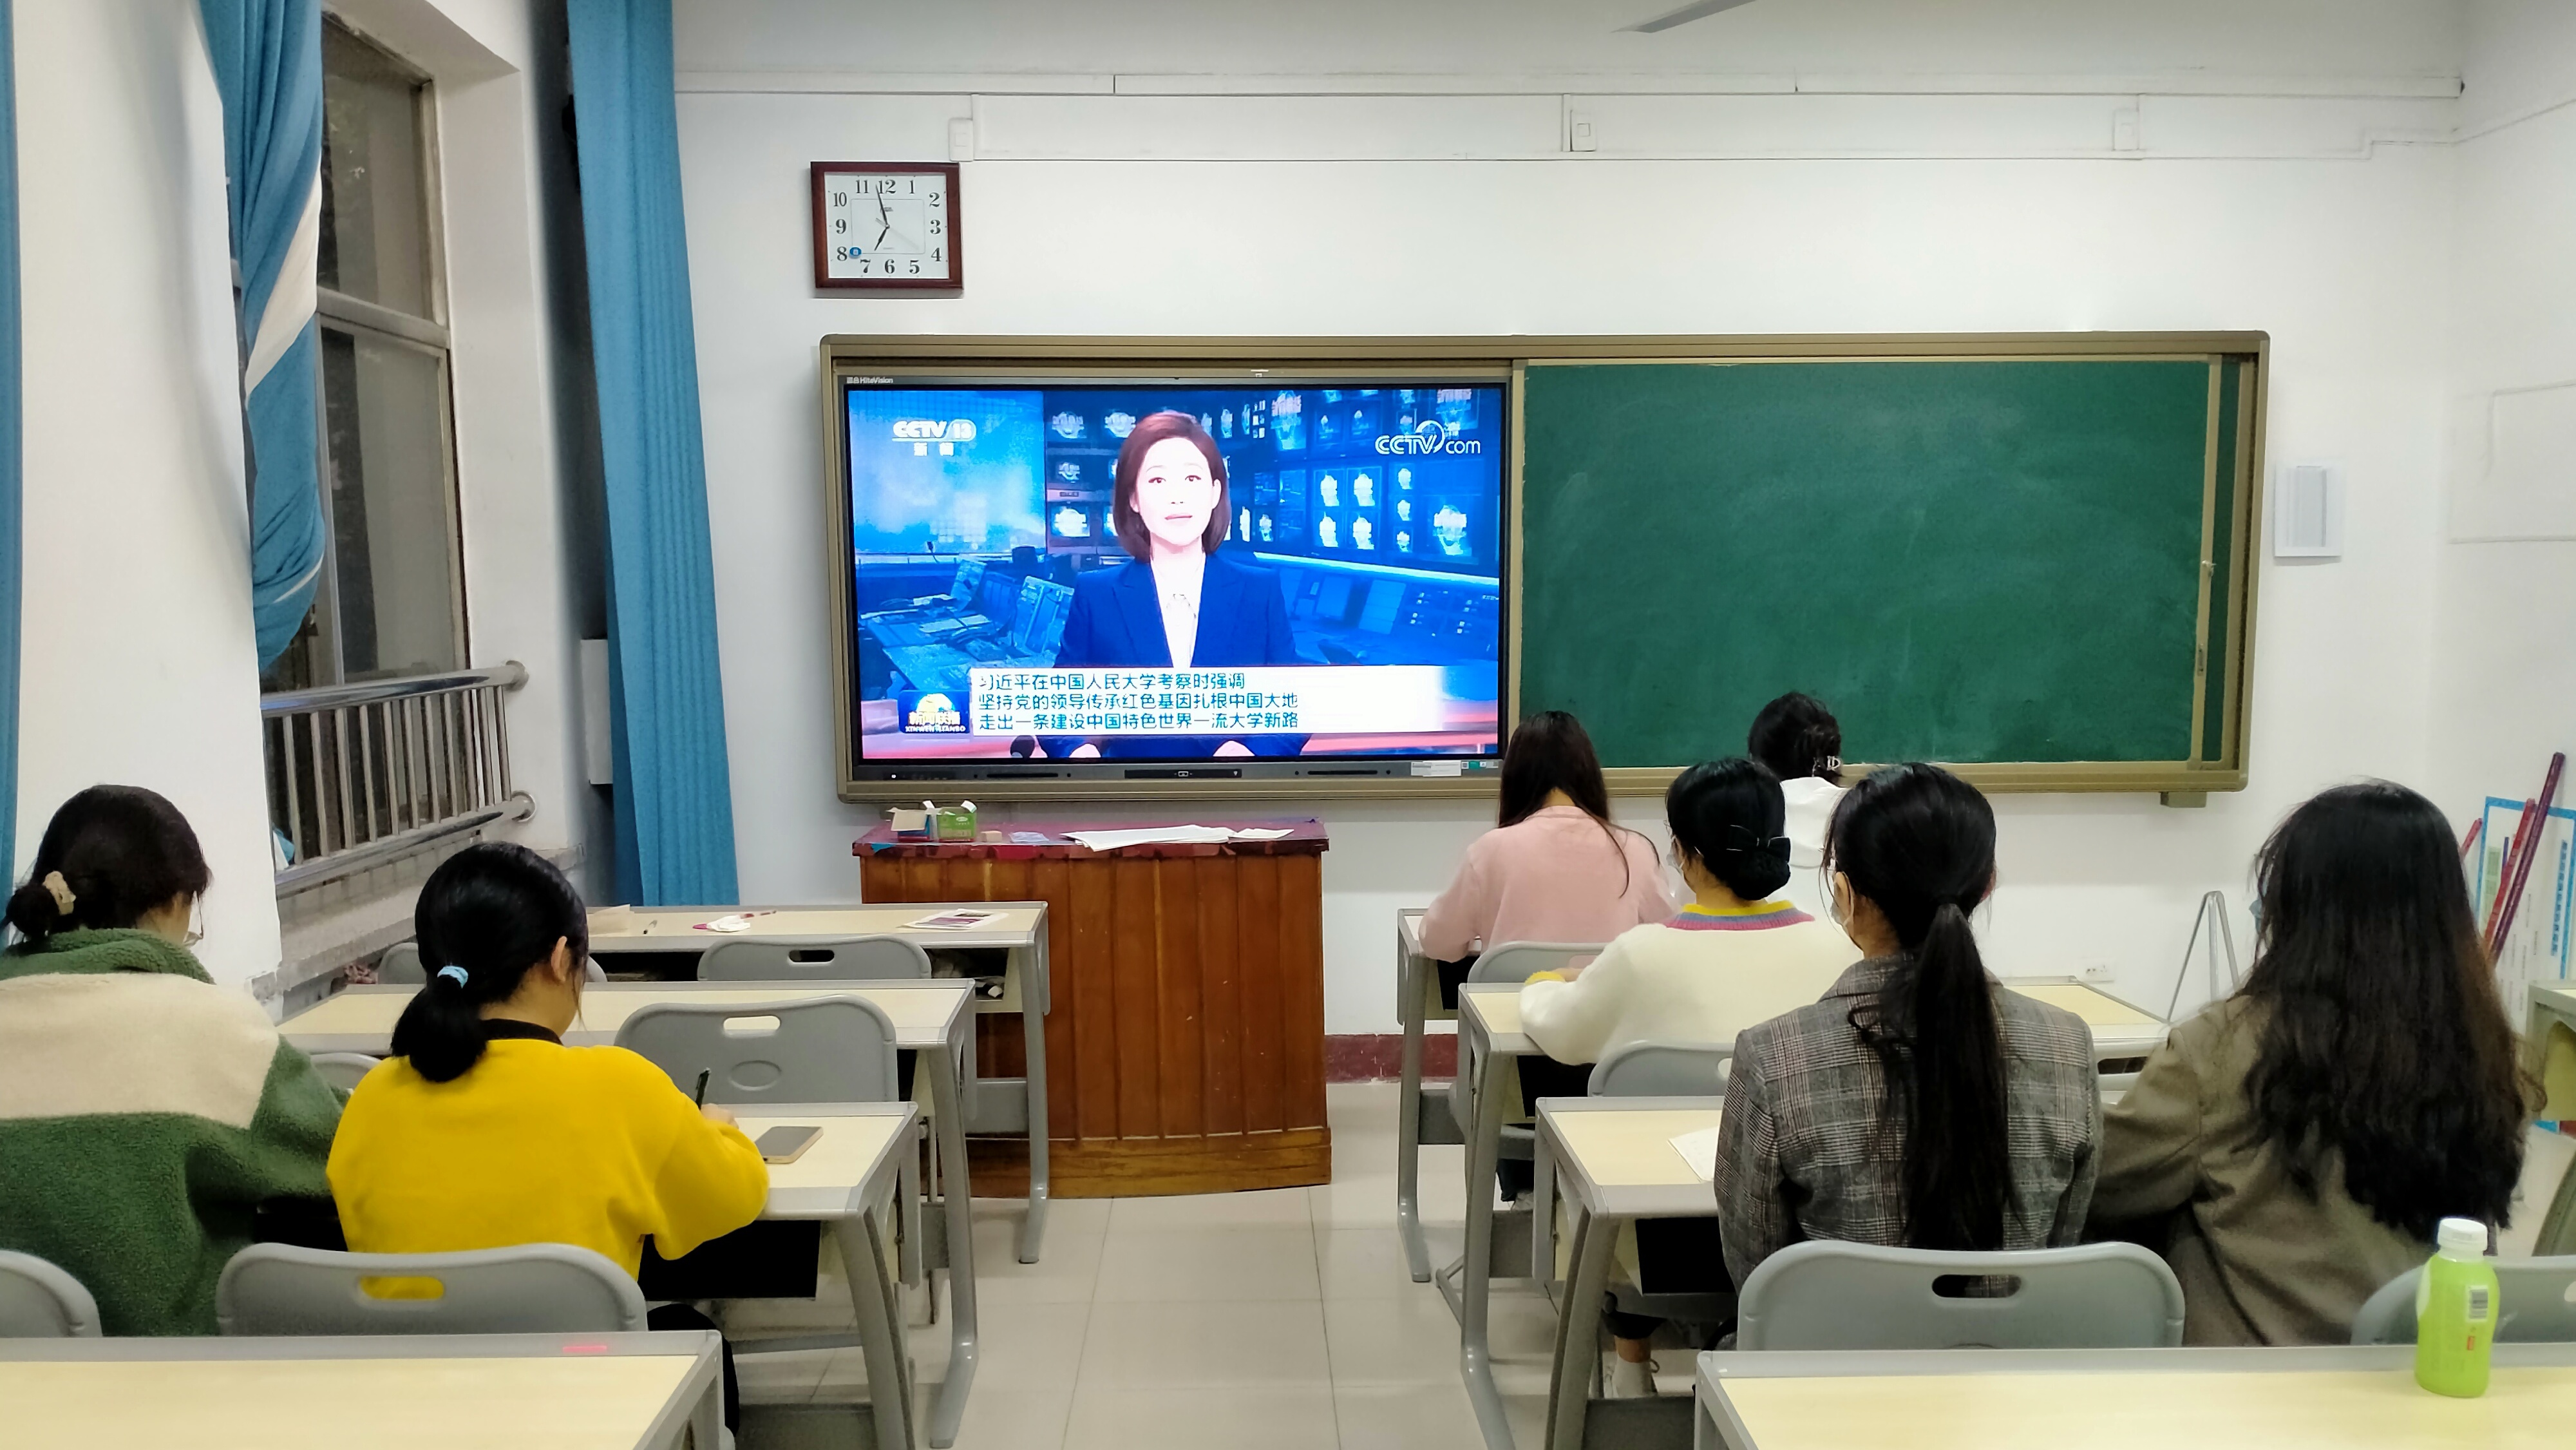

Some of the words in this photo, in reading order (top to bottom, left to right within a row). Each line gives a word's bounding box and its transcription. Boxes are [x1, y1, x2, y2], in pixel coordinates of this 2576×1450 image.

[856, 180, 869, 194] 11
[878, 180, 896, 194] 12
[909, 180, 915, 194] 1
[833, 192, 848, 207] 10
[929, 193, 940, 207] 2
[836, 219, 847, 234] 9
[930, 220, 941, 234] 3
[837, 247, 848, 261] 8
[931, 248, 942, 262] 4
[860, 259, 871, 273] 7
[885, 259, 895, 274] 6
[909, 260, 920, 274] 5
[893, 421, 947, 438] CCTV
[953, 423, 972, 439] 13
[1375, 435, 1437, 454] CCTV
[1446, 440, 1481, 454] com
[979, 673, 1245, 691] 习近平在中国人民大学考察时强调
[979, 692, 1298, 710] 坚持党的领导传承红色基因扎根中国大地
[979, 712, 1298, 730] 走出一条建设中国特色世界一流大学新路
